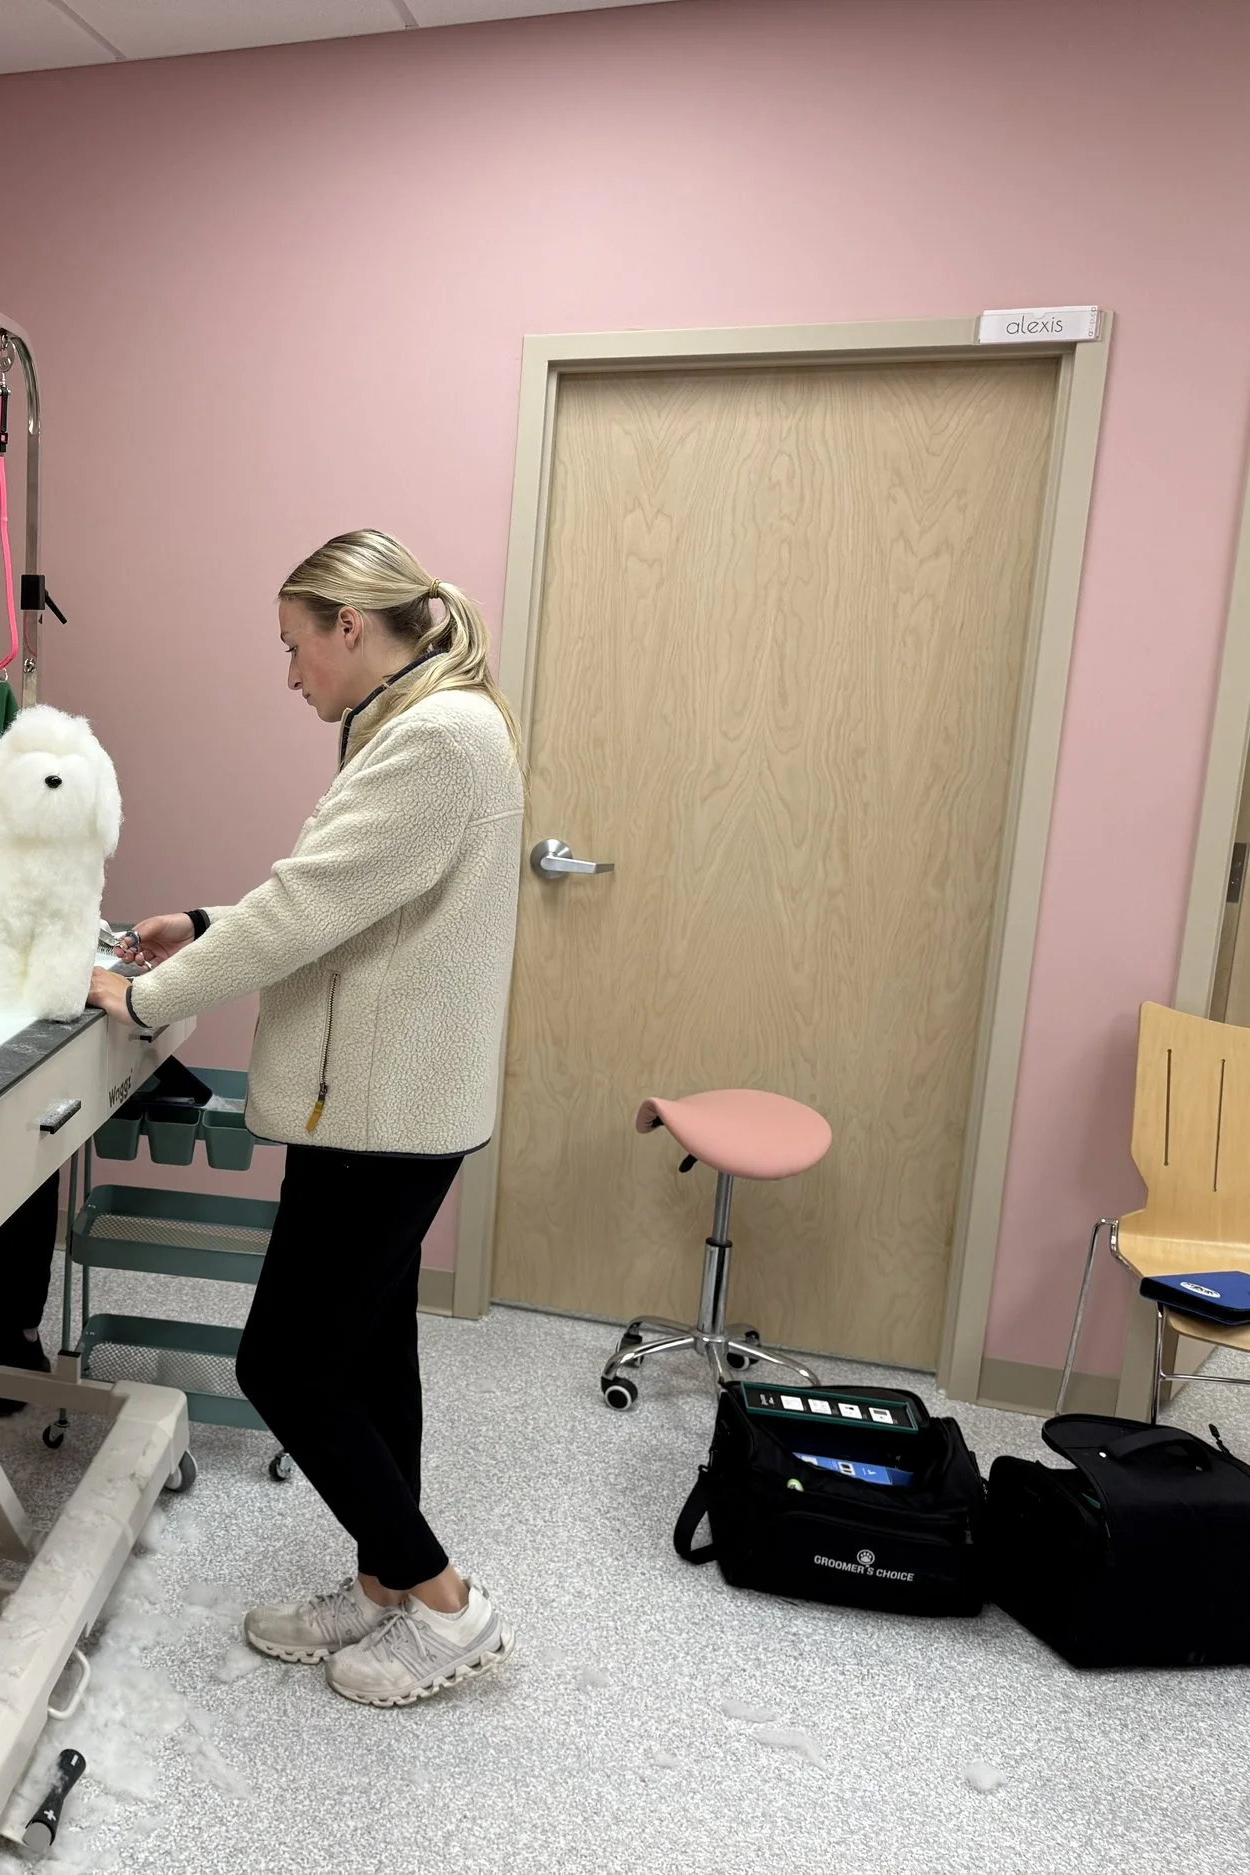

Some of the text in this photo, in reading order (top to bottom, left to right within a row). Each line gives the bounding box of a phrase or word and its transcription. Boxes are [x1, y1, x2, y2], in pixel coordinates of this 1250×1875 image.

[1006, 315, 1064, 335] alexis
[813, 1555, 915, 1582] GROOMER'S CHOICE
